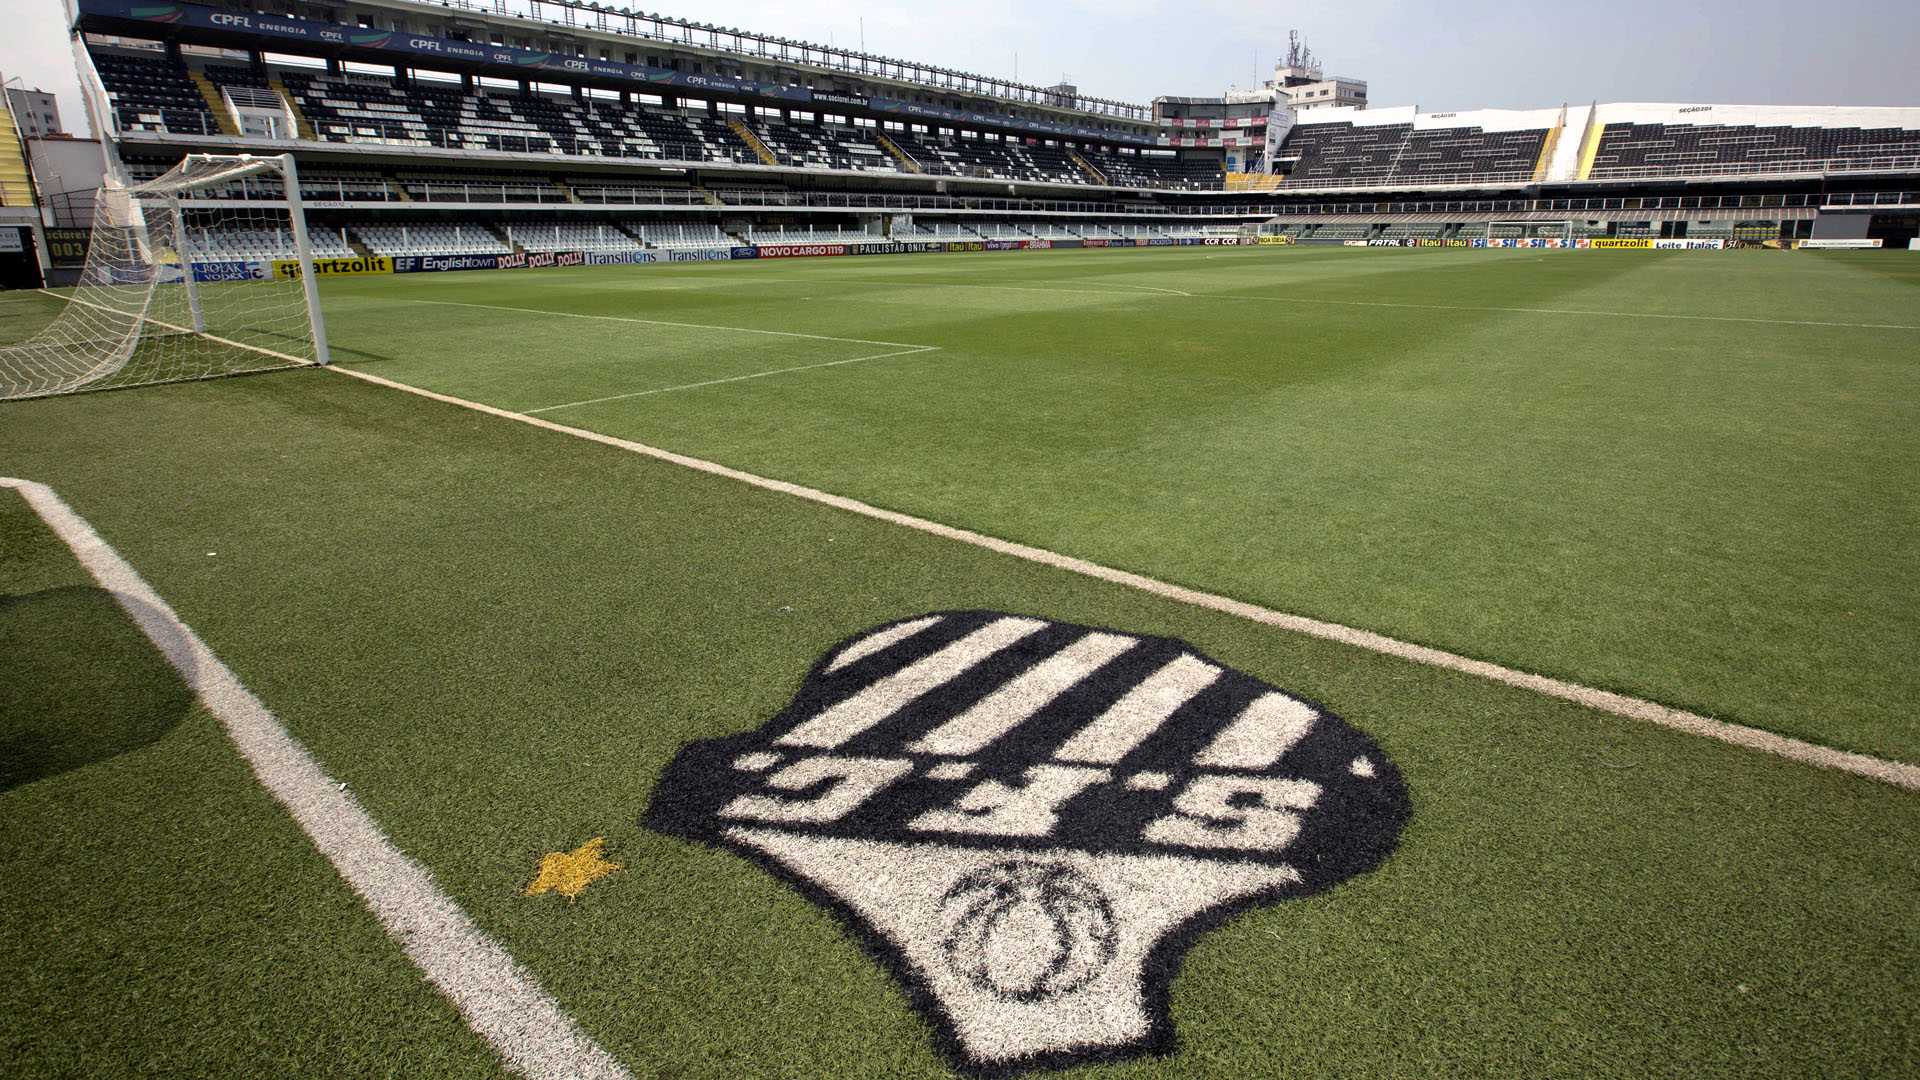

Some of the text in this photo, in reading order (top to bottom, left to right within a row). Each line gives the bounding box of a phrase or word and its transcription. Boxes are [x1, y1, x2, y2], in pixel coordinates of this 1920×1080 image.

[210, 13, 307, 35] CPFL ENERGIA
[319, 31, 343, 39] CPFL
[409, 39, 484, 57] CPFL ENERGIA
[564, 59, 624, 75] CPFL ENERGIA
[686, 75, 708, 85] CPFL
[813, 92, 868, 106] www.sociorei.com.br
[908, 105, 922, 113] CPFL
[949, 241, 965, 251] Itaú
[968, 241, 983, 250] Itaú
[1204, 238, 1219, 246] CCR
[1222, 238, 1238, 246] CCR
[1368, 239, 1401, 247] FATAL
[1421, 238, 1441, 247] Itaú
[1446, 238, 1466, 247] Itaú
[1474, 239, 1488, 248] Sil
[1502, 239, 1518, 248] Sil
[1530, 239, 1546, 248] Sil
[1595, 239, 1649, 248] quartzolit
[1686, 241, 1718, 249] Italac
[52, 242, 84, 257] 003
[760, 246, 844, 257] NOVO CARGO 1119
[859, 242, 927, 254] PAULISTÃO ONIX
[529, 252, 555, 268] DOLLY
[558, 251, 584, 267] DOLLY
[586, 251, 657, 264] Transitions
[666, 249, 729, 262] Transitions
[395, 256, 495, 271] EF Englishtown
[498, 253, 526, 269] DOLLY
